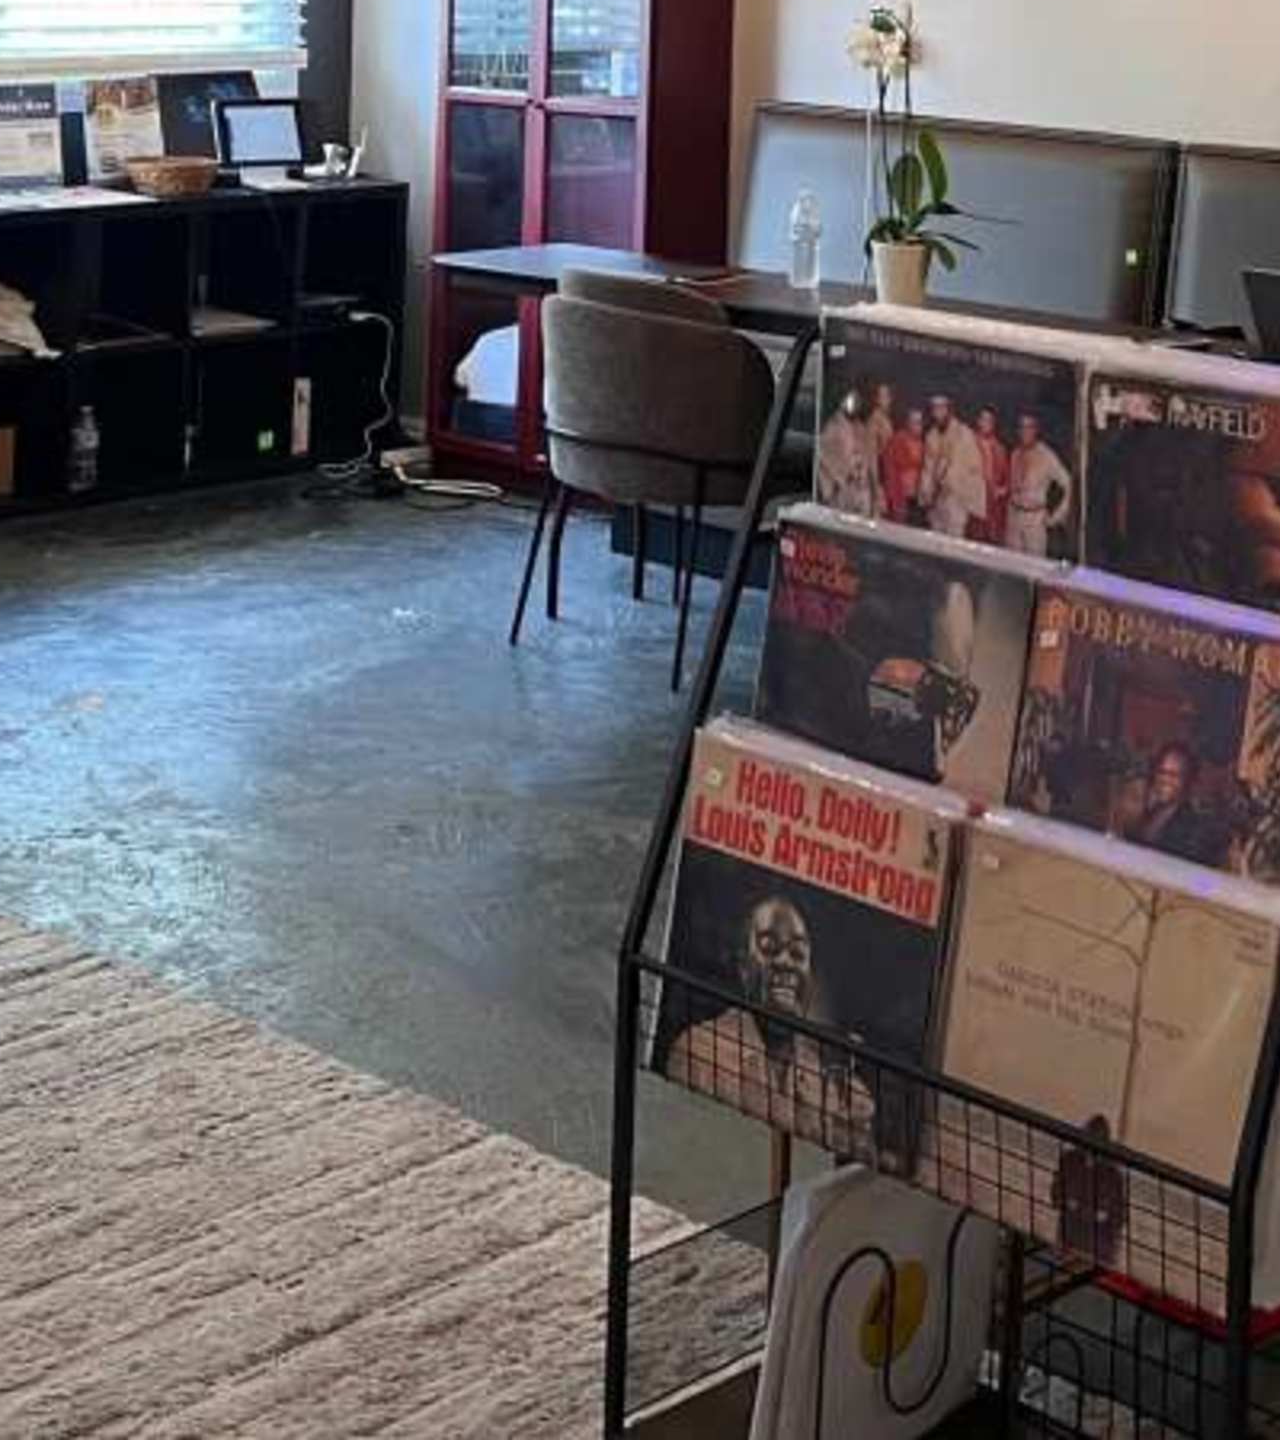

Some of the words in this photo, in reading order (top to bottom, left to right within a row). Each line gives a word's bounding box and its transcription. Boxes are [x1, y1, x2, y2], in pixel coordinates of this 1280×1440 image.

[693, 793, 768, 857] Louis
[773, 824, 938, 920] Armstrong
[816, 786, 902, 855] Dolly!
